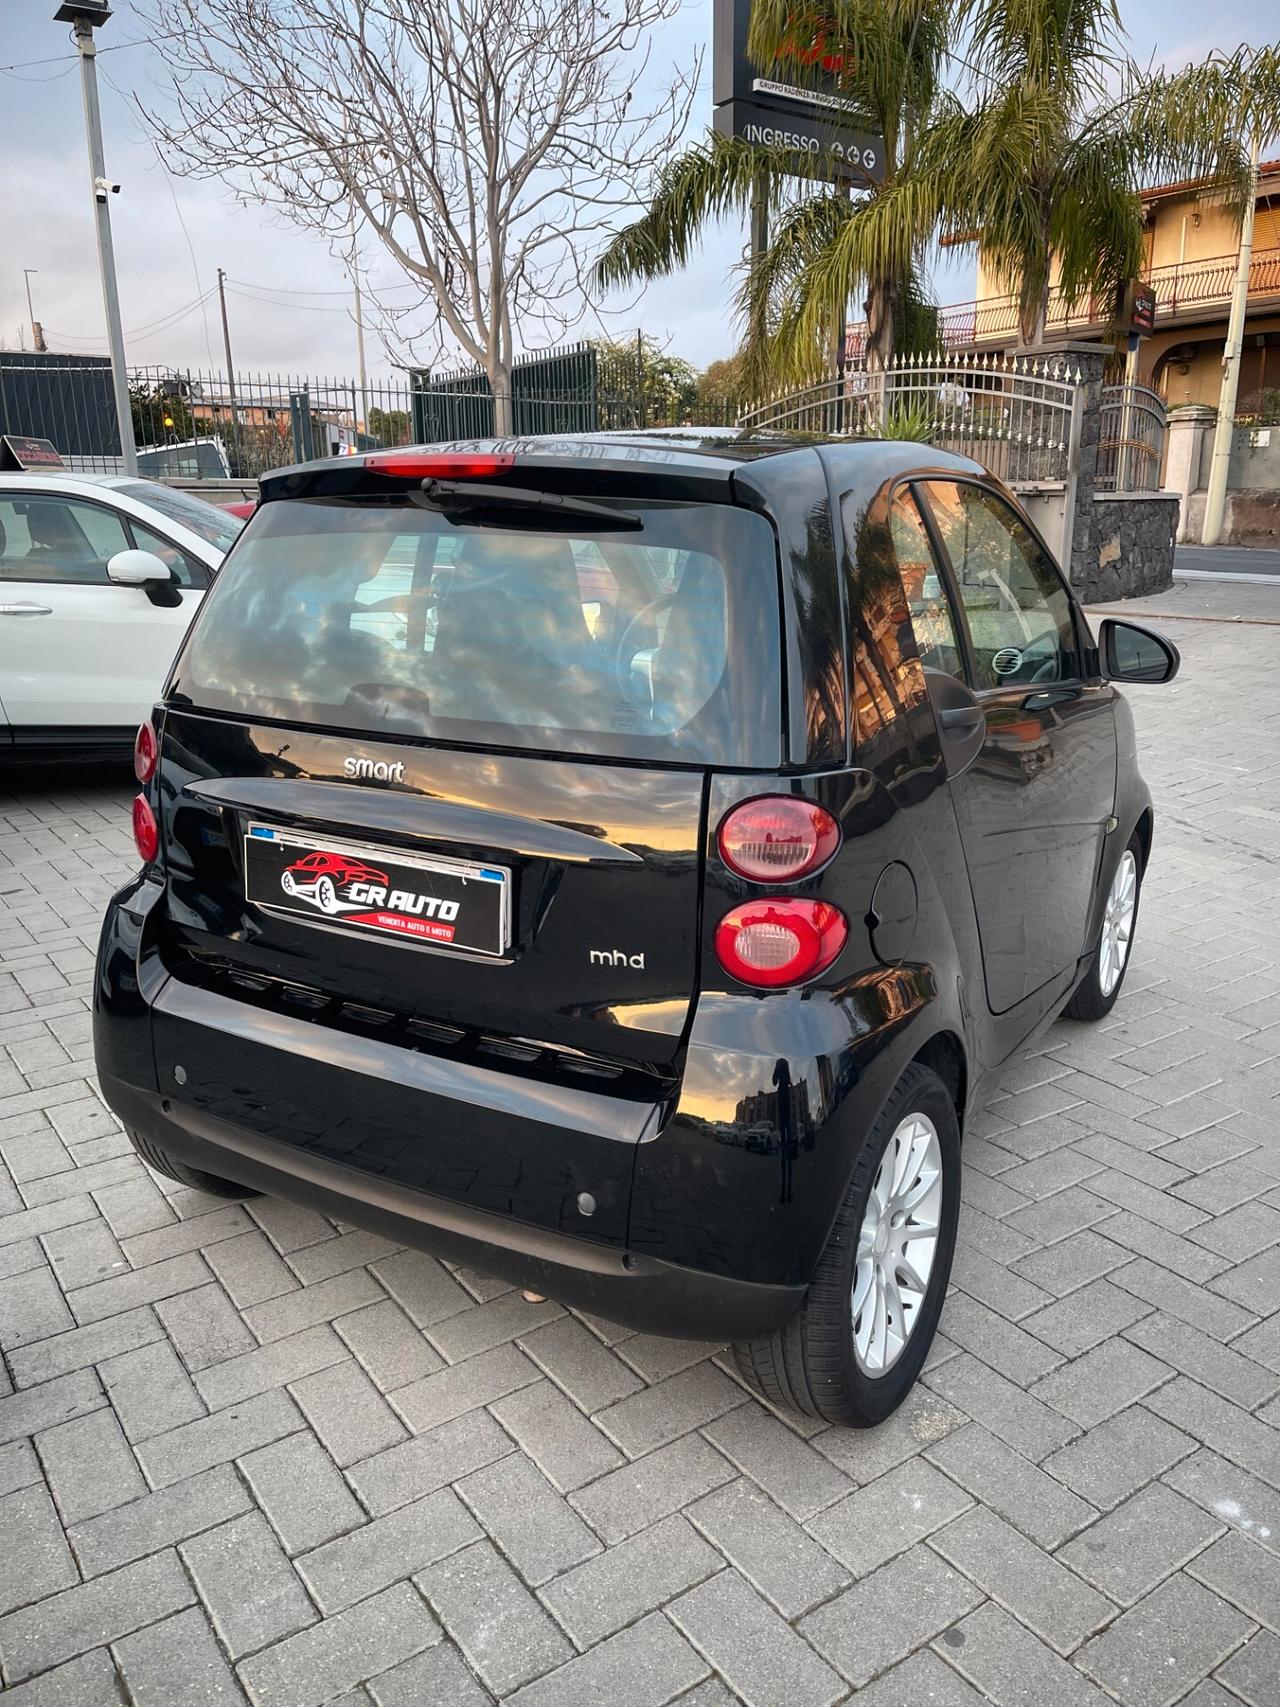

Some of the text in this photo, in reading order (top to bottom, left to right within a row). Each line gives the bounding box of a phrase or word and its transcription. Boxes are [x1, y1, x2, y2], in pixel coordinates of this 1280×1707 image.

[759, 81, 784, 93] GRUPPO
[746, 123, 820, 154] INGRESSO
[343, 757, 405, 783] smart
[346, 882, 460, 921] GR AUTO
[378, 916, 405, 928] VENDITA
[407, 922, 425, 932] AUTO
[431, 927, 452, 938] MOTO
[589, 948, 645, 969] mhd
